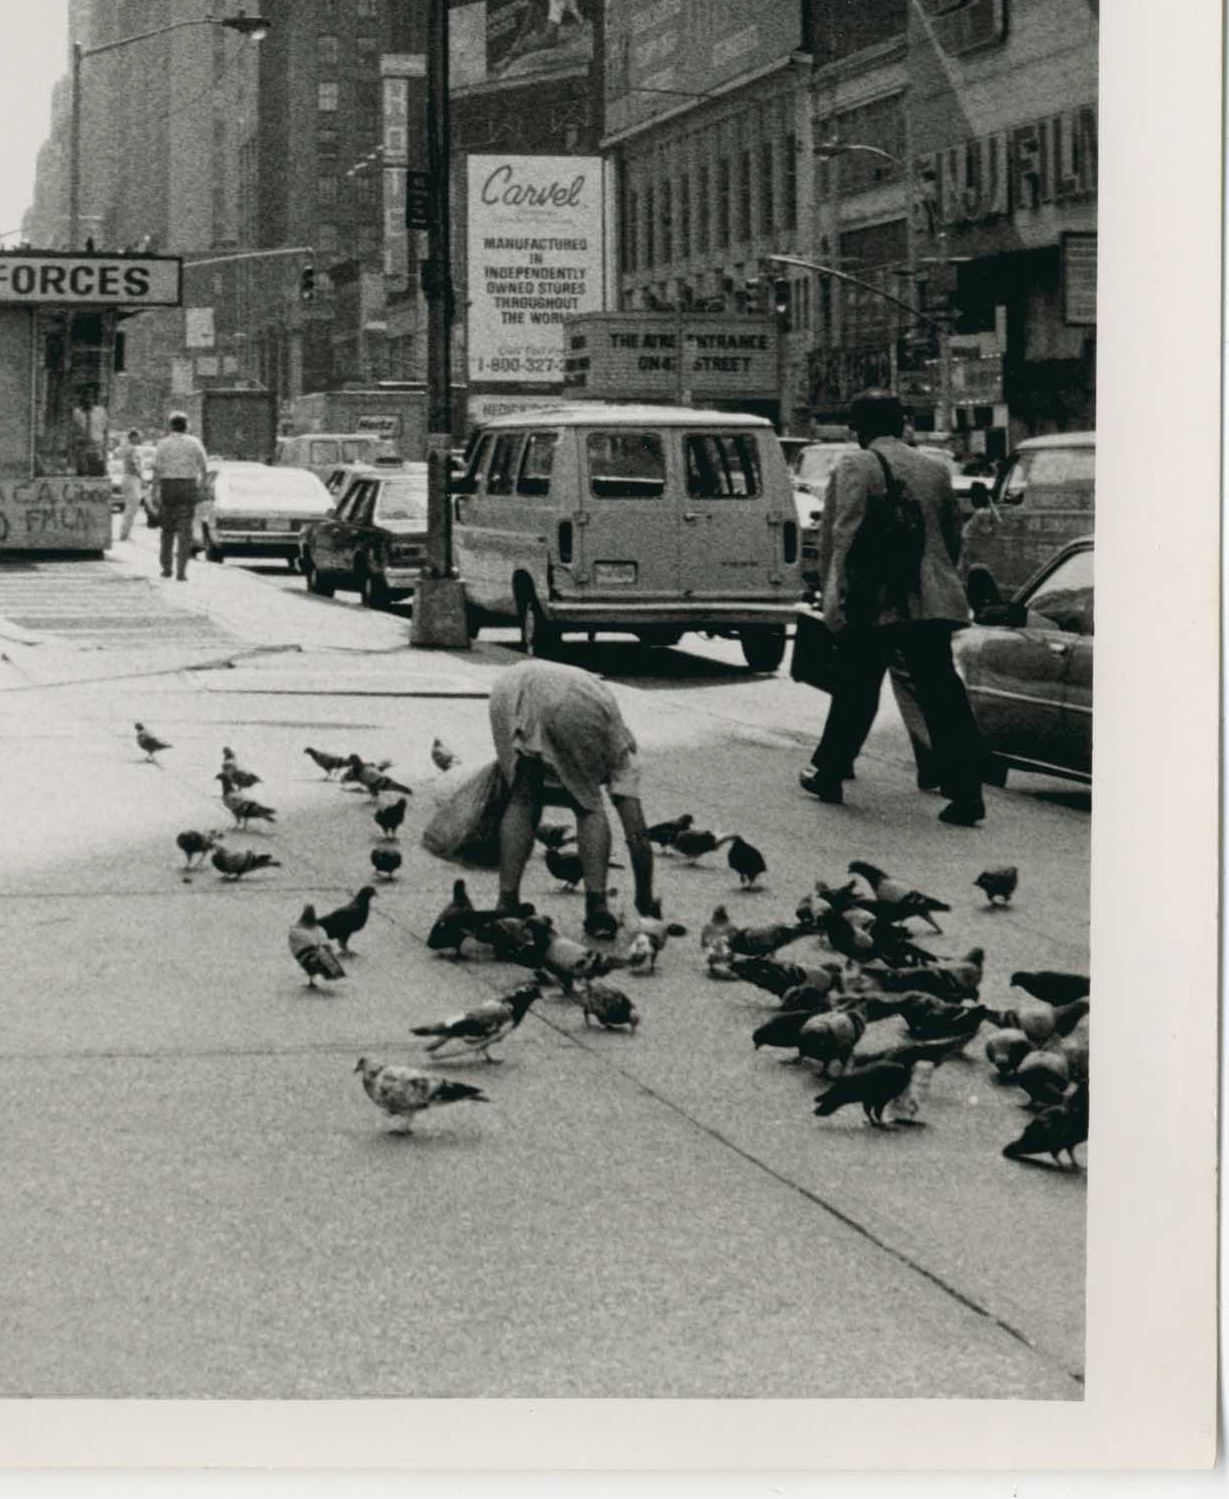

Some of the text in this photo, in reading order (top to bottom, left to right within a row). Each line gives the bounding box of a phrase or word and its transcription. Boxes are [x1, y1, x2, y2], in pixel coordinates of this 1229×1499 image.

[480, 165, 586, 208] Carvel
[483, 238, 587, 251] MANUFACTURED
[529, 253, 543, 265] IN
[484, 267, 587, 280] INDEPENDENTLY
[486, 282, 587, 295] OWNED STORES
[493, 297, 579, 309] THROUGHOUT
[501, 311, 525, 324] THE
